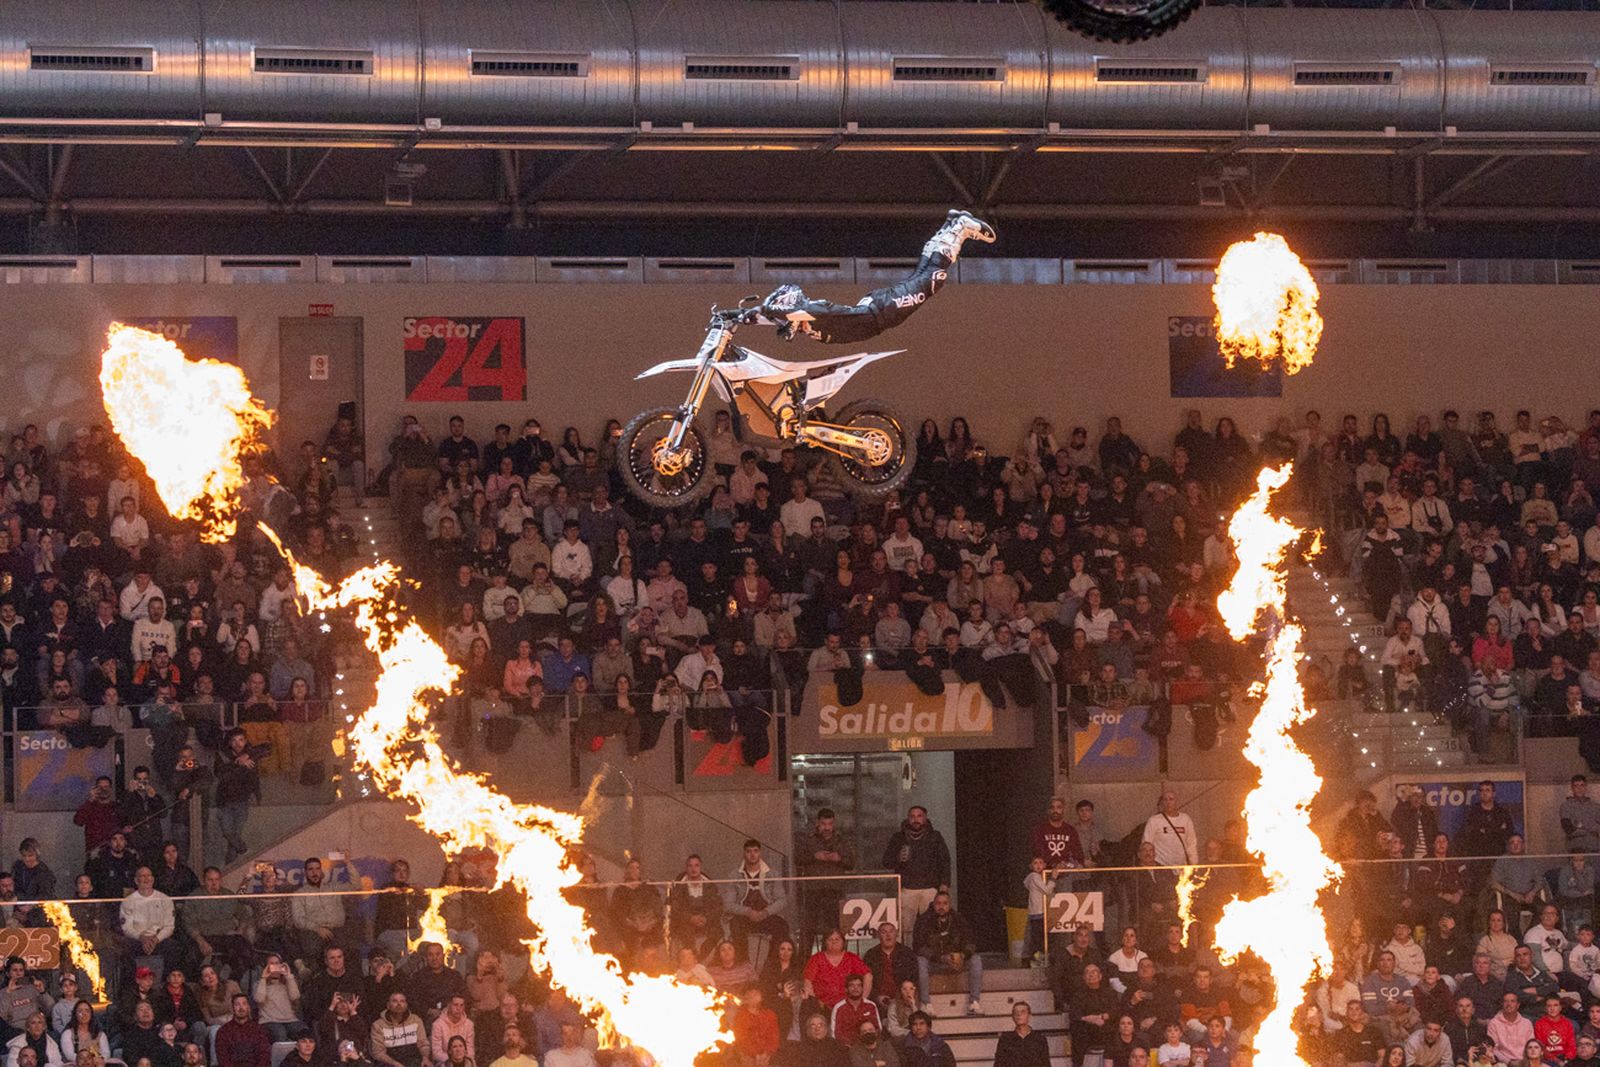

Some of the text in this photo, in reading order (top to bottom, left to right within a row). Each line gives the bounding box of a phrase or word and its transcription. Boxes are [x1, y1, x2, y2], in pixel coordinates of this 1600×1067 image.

[403, 318, 481, 338] Sector
[403, 317, 527, 401] 24
[818, 682, 990, 735] Salida 10
[1089, 712, 1124, 725] ctor
[20, 735, 72, 750] Secto
[890, 738, 923, 749] SALIDA
[842, 897, 899, 940] 24
[1049, 891, 1105, 933] 24
[0, 927, 60, 969] 23
